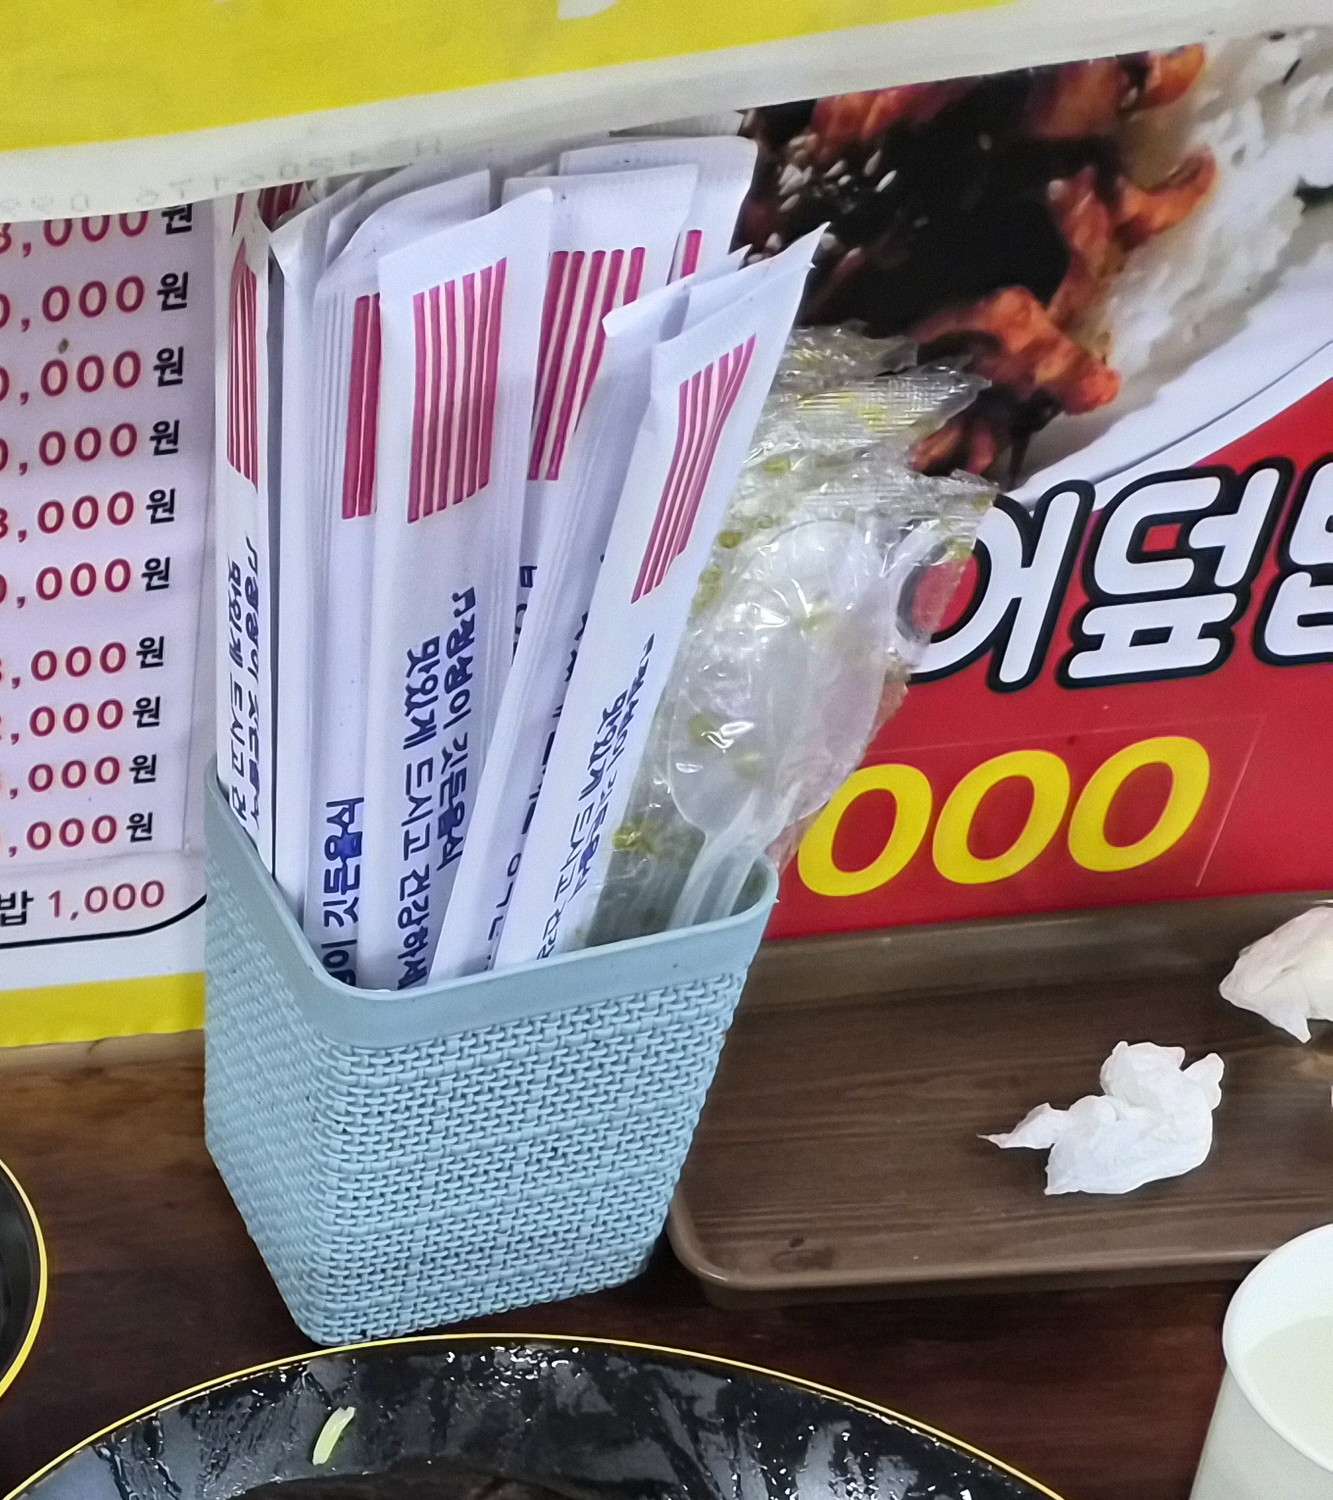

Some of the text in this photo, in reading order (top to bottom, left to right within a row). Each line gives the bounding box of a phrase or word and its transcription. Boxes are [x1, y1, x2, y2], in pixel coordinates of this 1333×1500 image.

[401, 635, 441, 751] 맛있게
[400, 755, 435, 862] 드시고
[47, 879, 166, 922] 1,000
